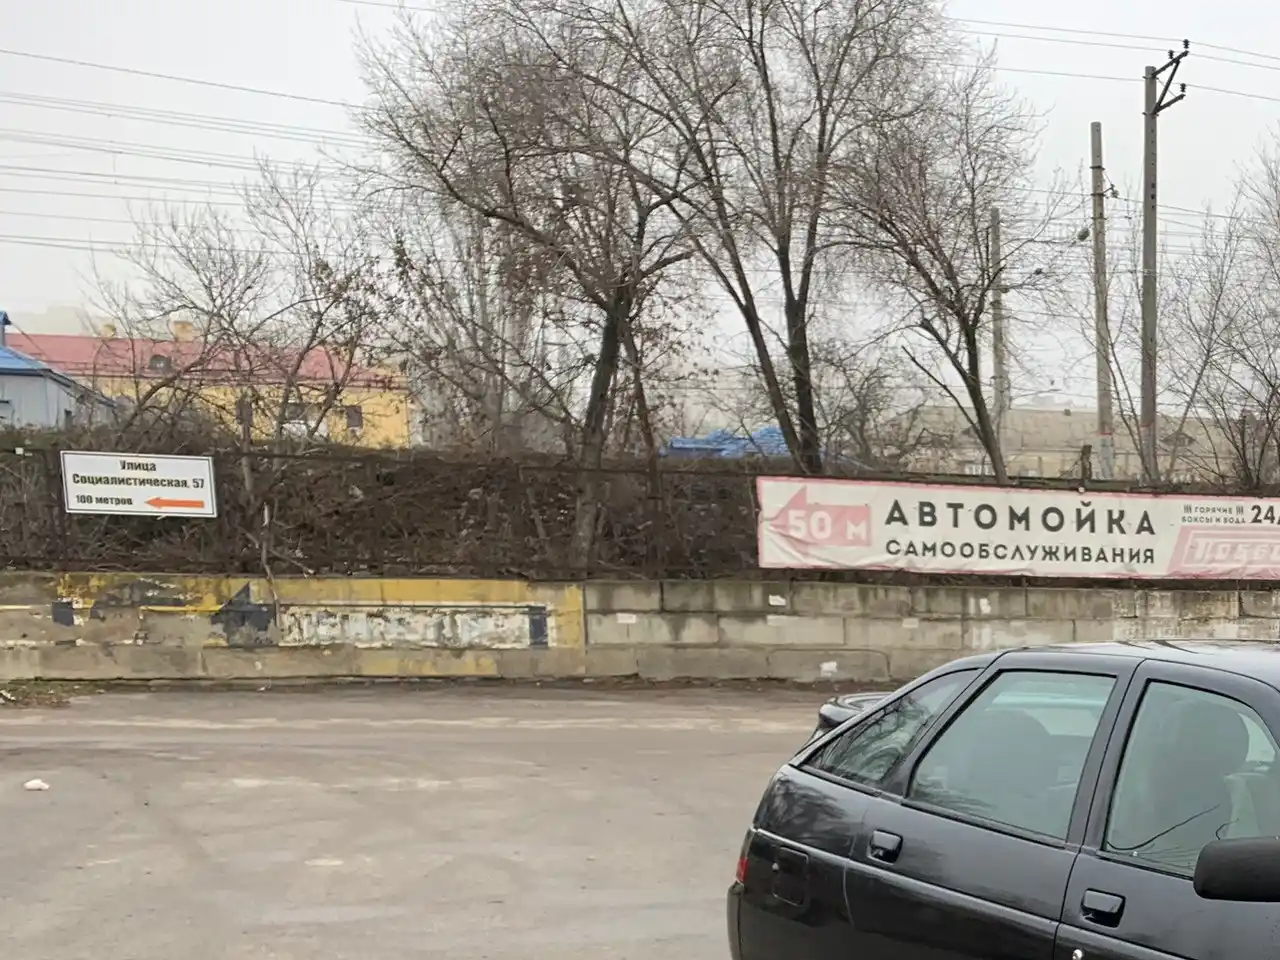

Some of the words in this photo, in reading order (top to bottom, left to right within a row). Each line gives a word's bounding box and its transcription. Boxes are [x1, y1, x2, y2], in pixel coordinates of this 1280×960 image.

[119, 459, 157, 473] Улица
[192, 477, 205, 489] 57
[76, 494, 93, 504] 100
[95, 496, 133, 506] метров
[1194, 506, 1233, 515] ГОРЯЧИЕ
[787, 508, 833, 540] 50
[884, 499, 1156, 536] АВТОМОЙКА
[1181, 515, 1213, 524] БОКСЫ
[1223, 516, 1247, 525] ВОДА
[886, 539, 1155, 564] САМООБСЛУЖИВАНИЯ
